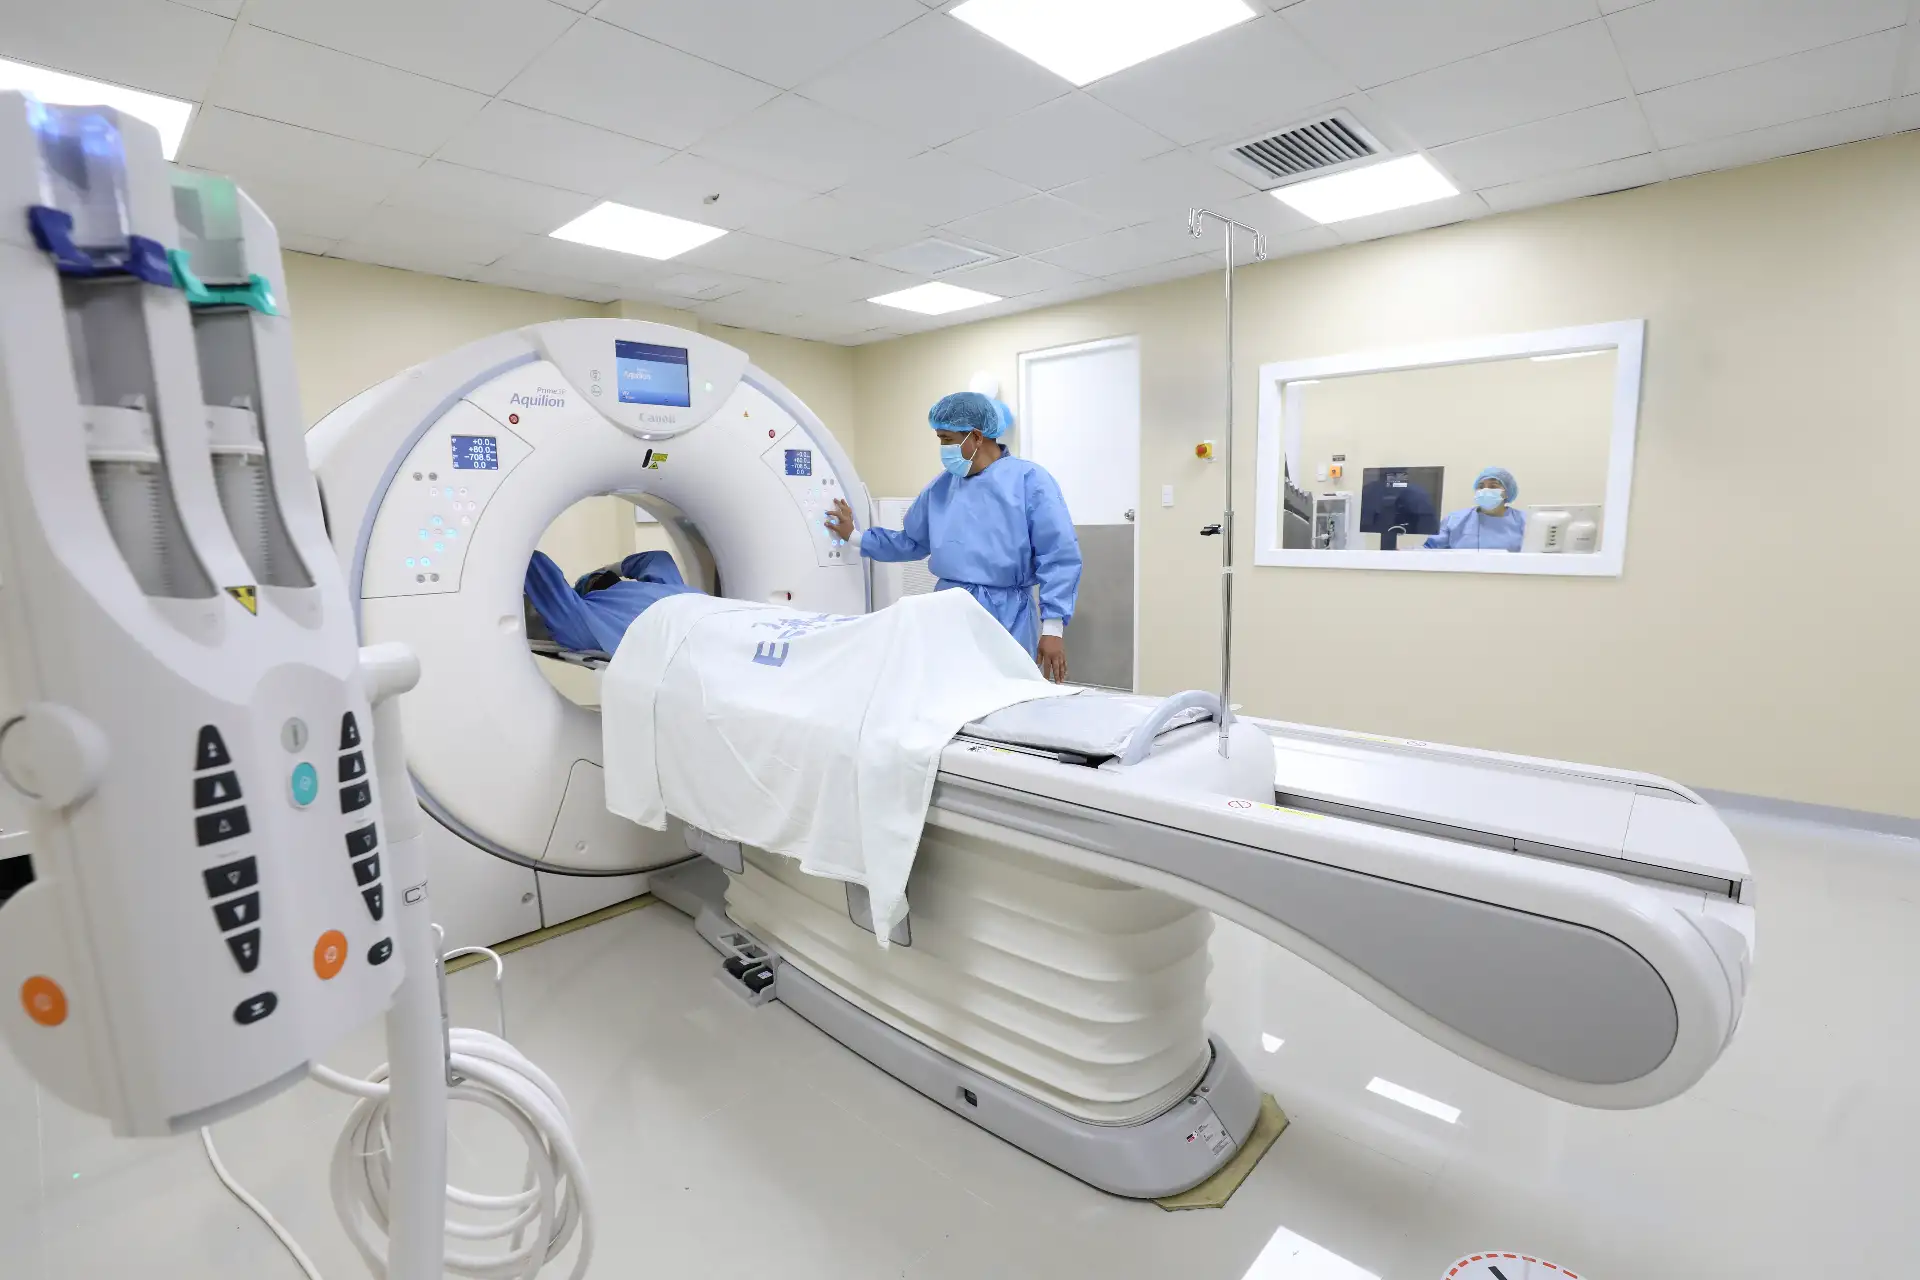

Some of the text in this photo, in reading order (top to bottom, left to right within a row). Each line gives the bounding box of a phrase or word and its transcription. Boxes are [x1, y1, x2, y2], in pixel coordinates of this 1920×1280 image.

[510, 392, 565, 409] Aquilion
[472, 438, 490, 446] +0.0
[468, 445, 491, 453] +80.0
[463, 453, 491, 461] -708.5
[473, 461, 486, 469] 0.0
